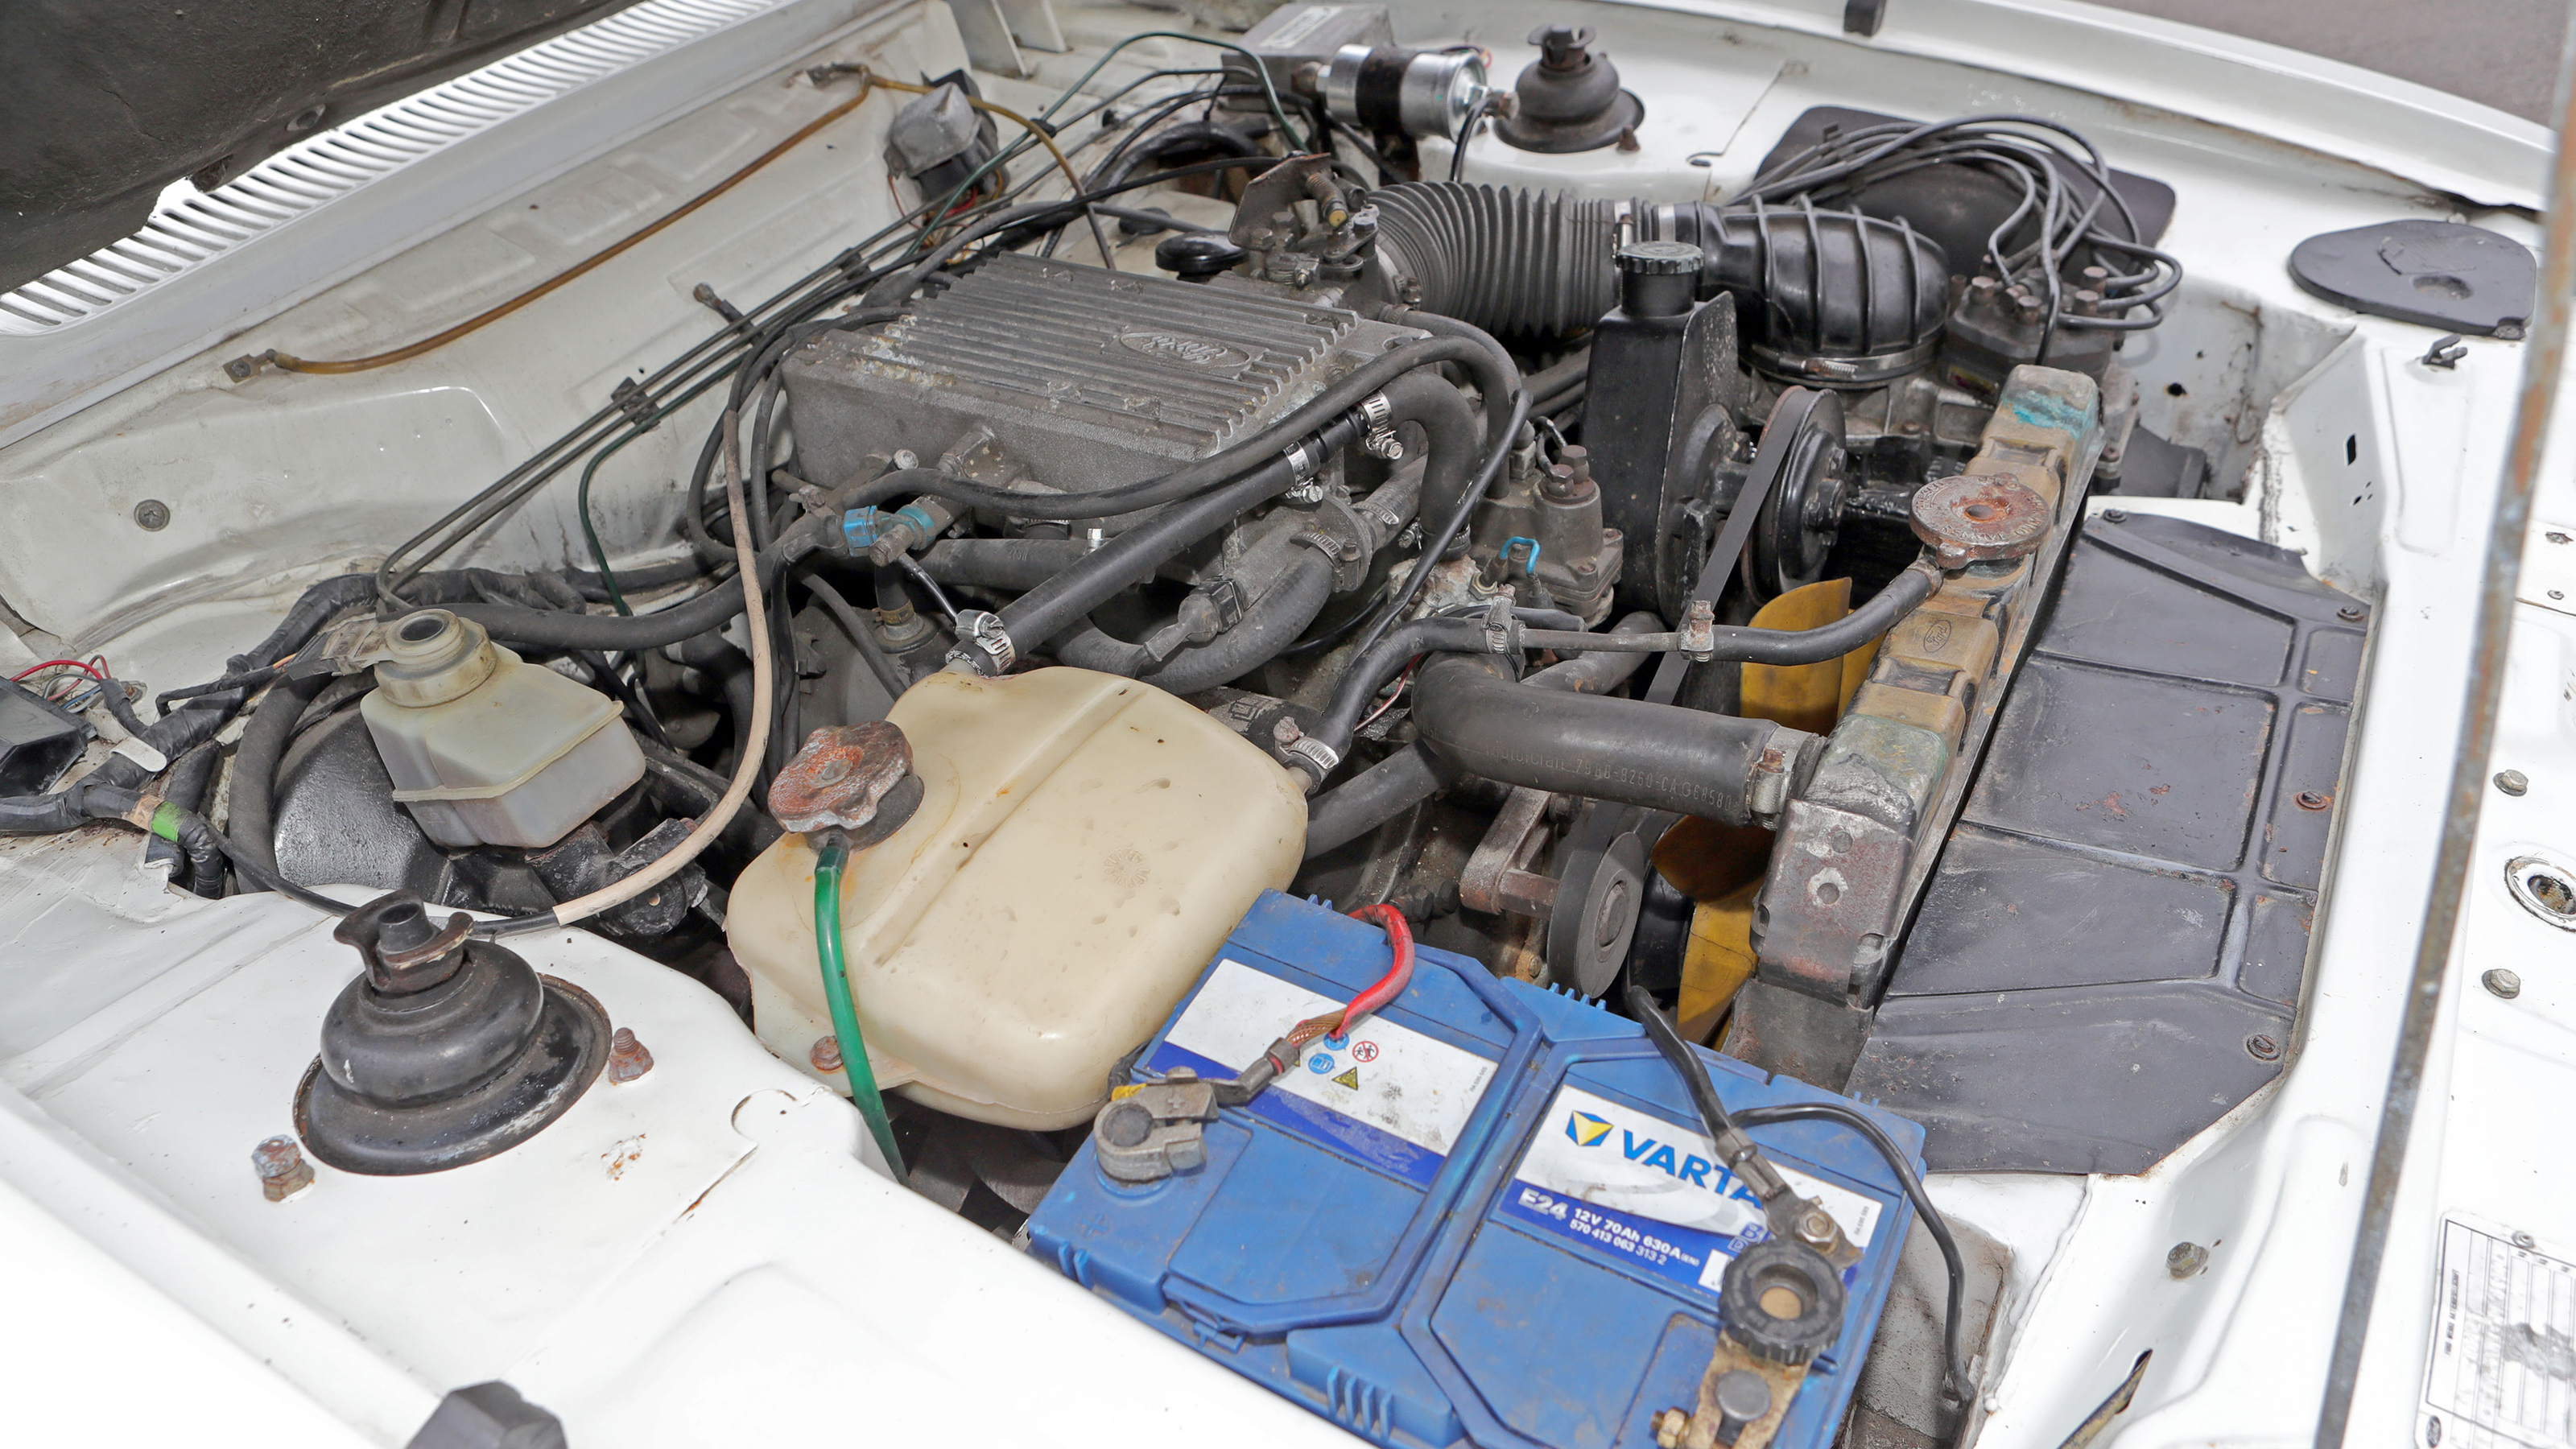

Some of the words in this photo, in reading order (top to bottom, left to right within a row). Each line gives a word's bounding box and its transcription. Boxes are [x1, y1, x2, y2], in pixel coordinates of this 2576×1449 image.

[1926, 625, 1947, 646] Ford
[1624, 1129, 1763, 1211] VARTA
[1517, 1187, 1569, 1221] E24
[1575, 1208, 1603, 1225] 12V
[1604, 1219, 1641, 1242] 70Ah
[1570, 1219, 1591, 1235] 570
[1591, 1228, 1613, 1244] 413
[1613, 1236, 1635, 1253] 063
[1636, 1245, 1657, 1261] 313
[1657, 1254, 1667, 1265] 2
